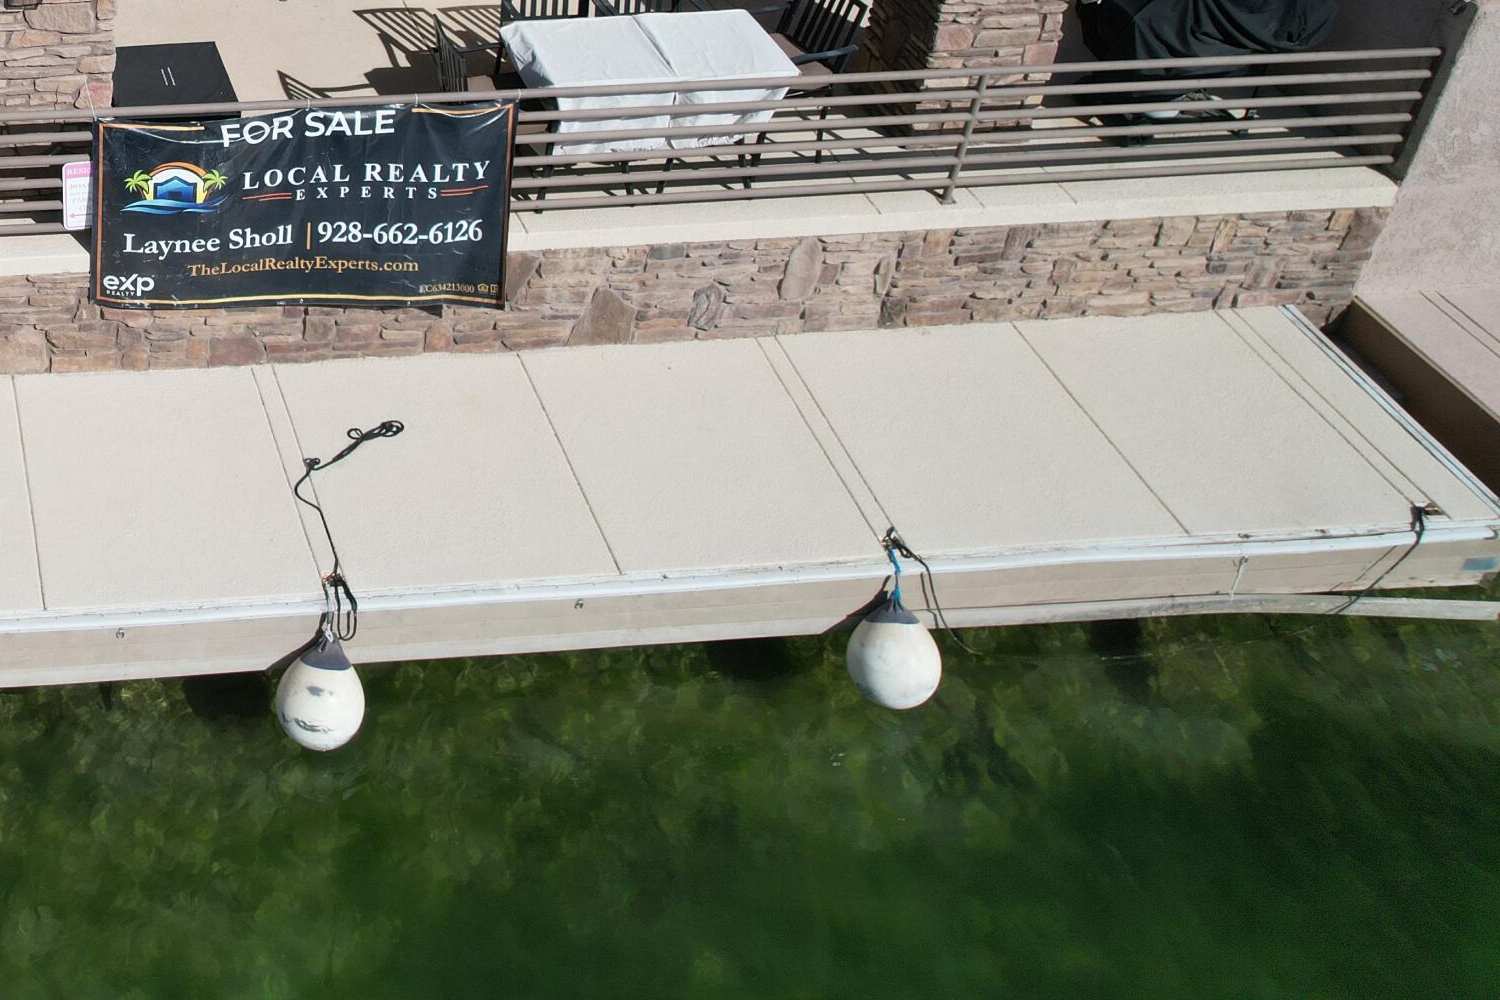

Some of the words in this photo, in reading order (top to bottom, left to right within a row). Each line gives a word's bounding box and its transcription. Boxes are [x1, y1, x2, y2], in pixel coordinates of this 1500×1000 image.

[221, 116, 294, 148] FOR
[304, 110, 396, 138] SALE
[242, 164, 350, 190] LOCAL
[364, 160, 490, 184] REALTY
[295, 186, 438, 201] EXPERTS
[123, 233, 221, 261] Laynee
[228, 224, 293, 250] Sholl
[317, 219, 483, 245] 928-662-6126
[187, 255, 419, 277] TheLocalRealtyExperts.com
